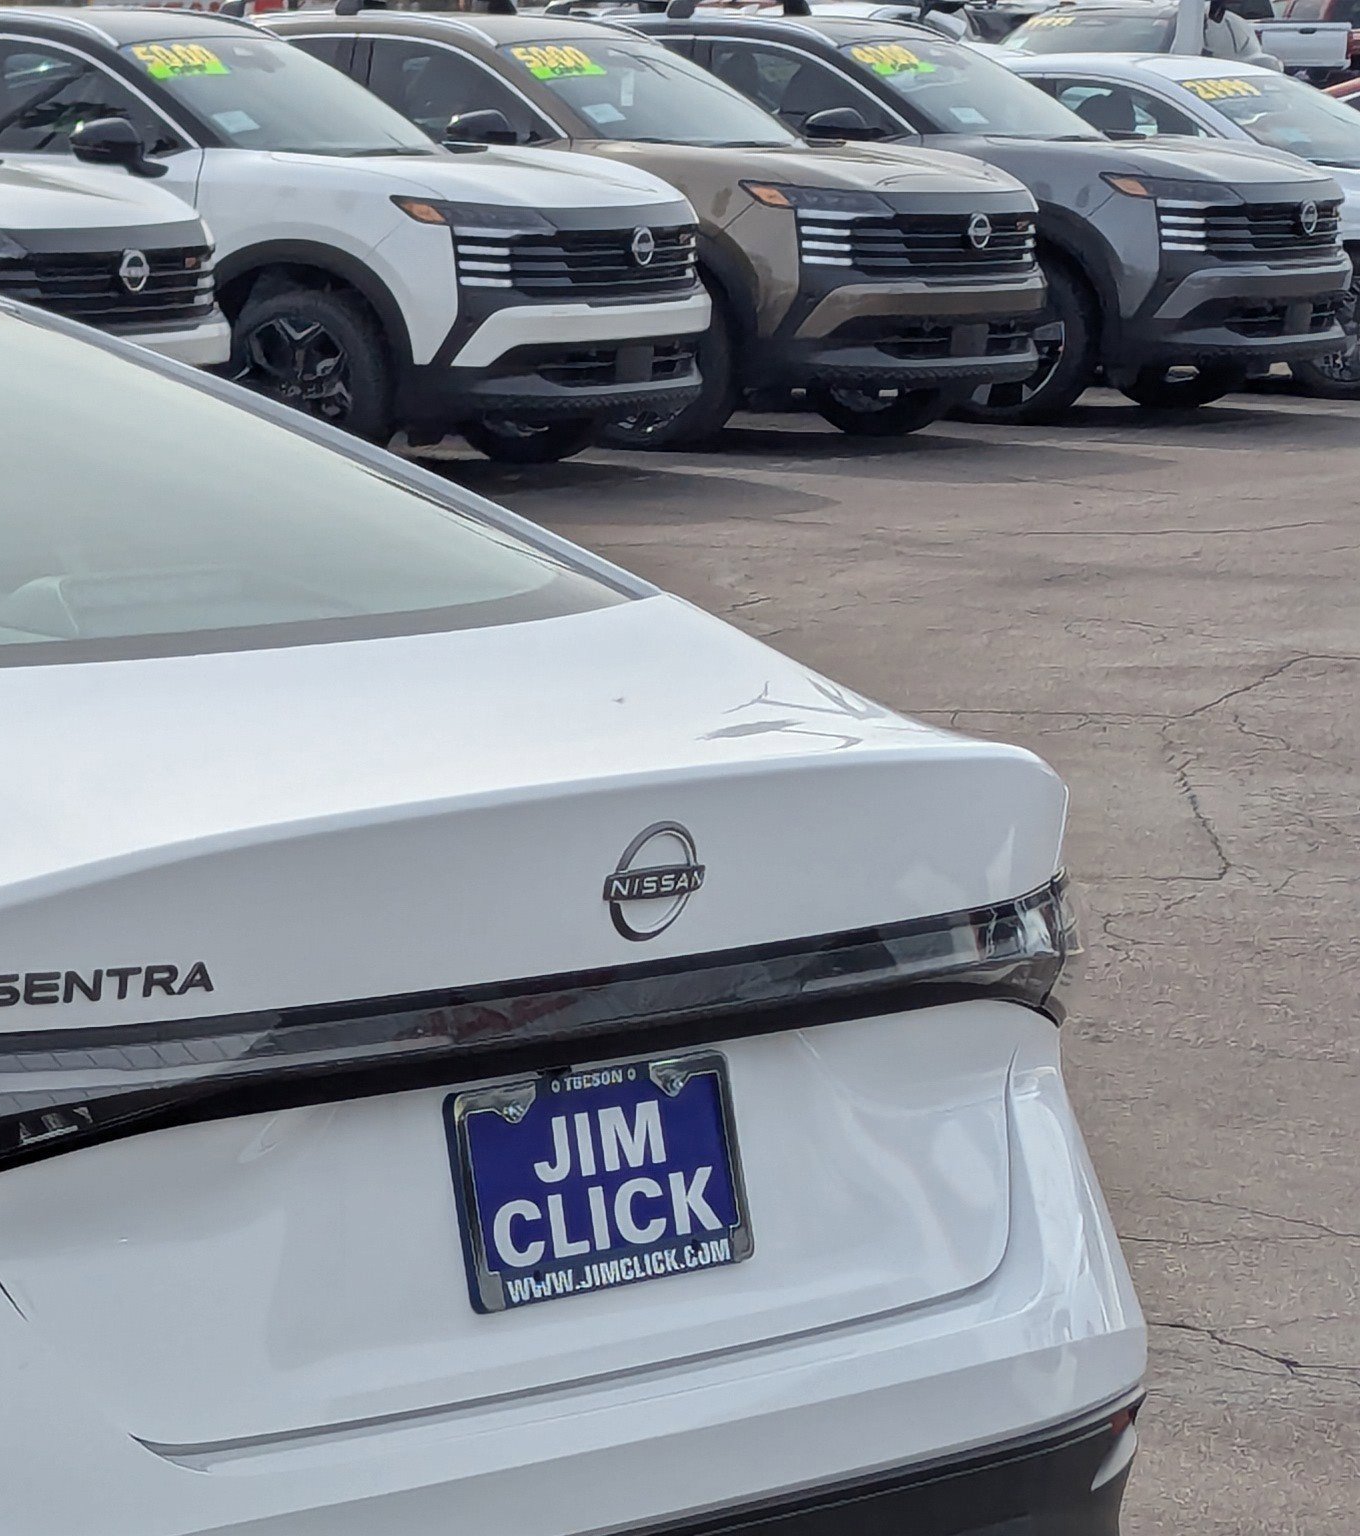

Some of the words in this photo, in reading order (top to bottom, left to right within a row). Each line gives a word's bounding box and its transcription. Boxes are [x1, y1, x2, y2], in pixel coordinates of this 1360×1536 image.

[610, 870, 702, 898] NISSAN
[533, 1099, 667, 1184] JIM
[493, 1165, 723, 1268] CLICK
[505, 1238, 731, 1304] WWW.JIMCLICK.COM
